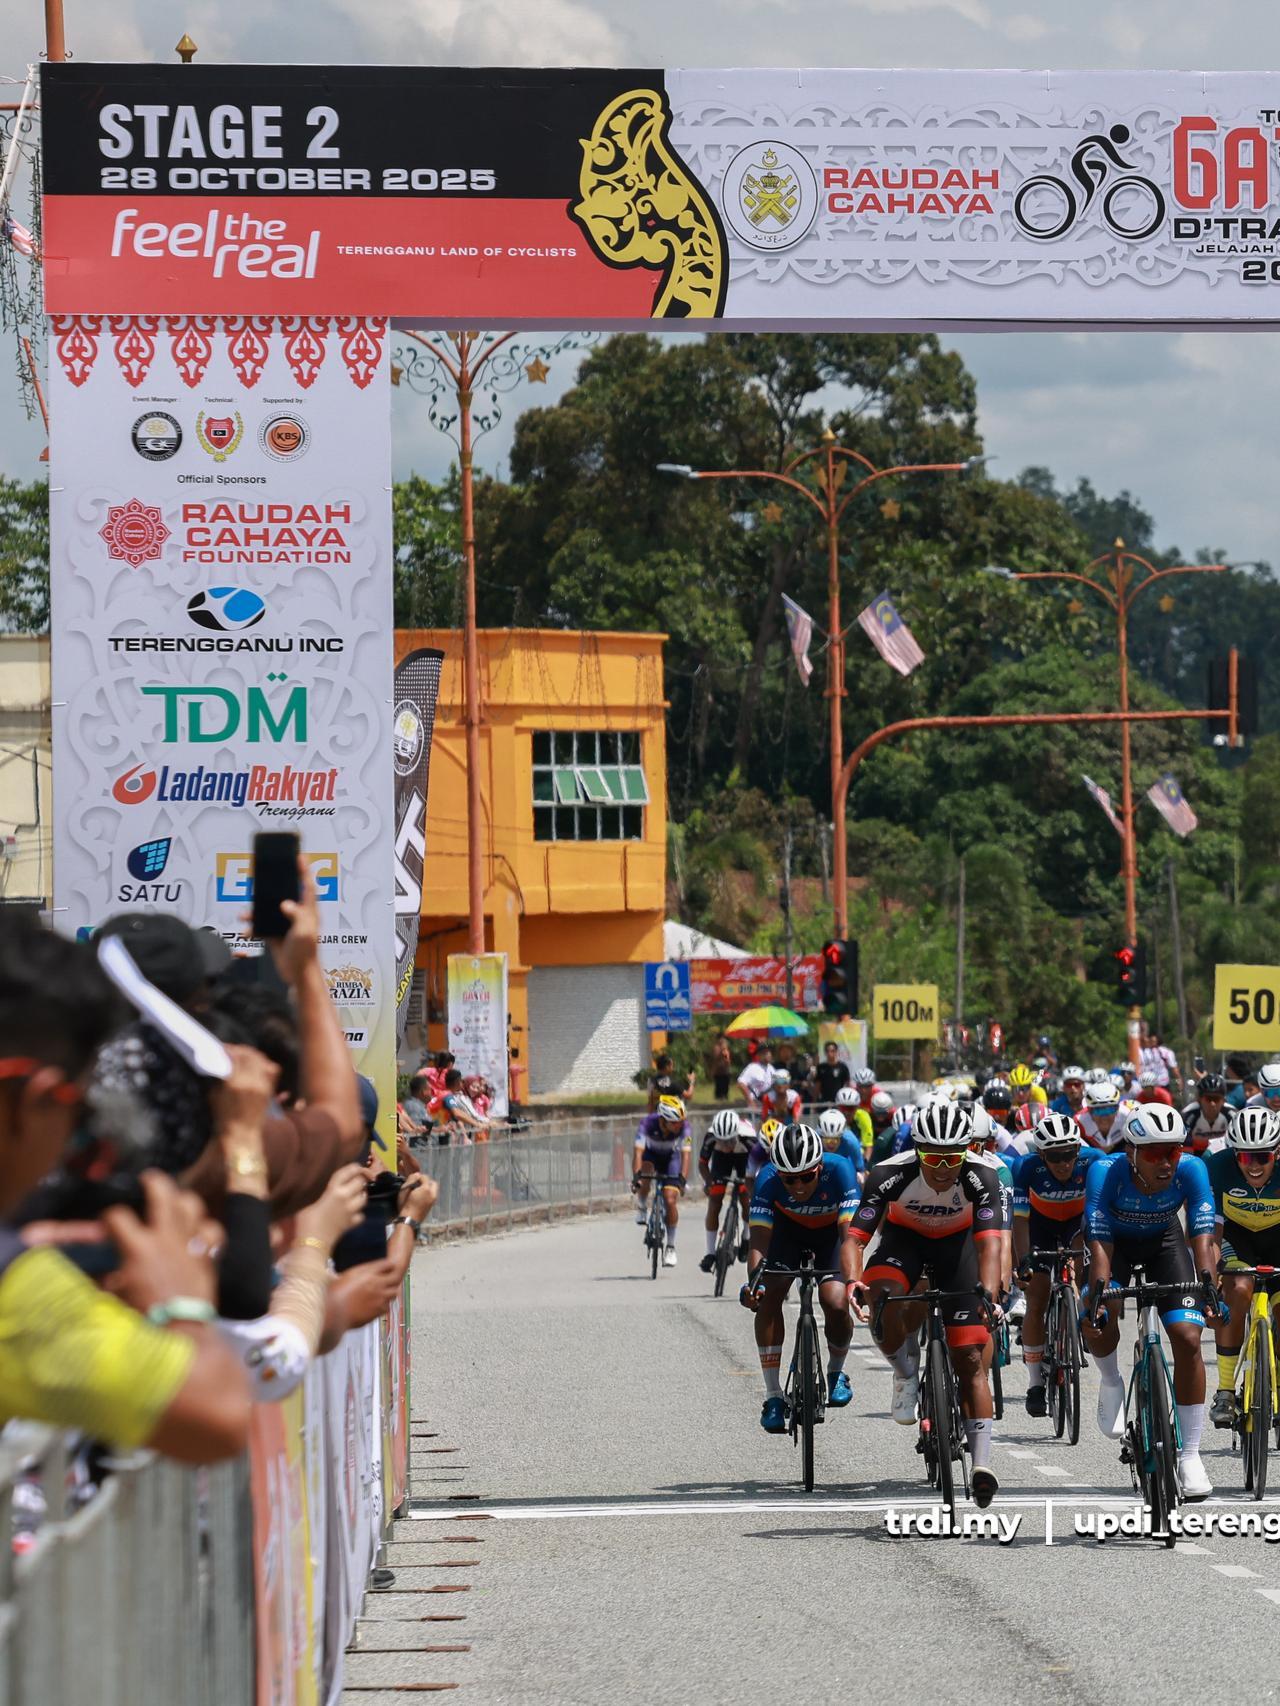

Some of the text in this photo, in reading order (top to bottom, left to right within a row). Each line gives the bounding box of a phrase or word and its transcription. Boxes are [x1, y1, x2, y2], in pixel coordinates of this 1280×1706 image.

[99, 104, 340, 159] STAGE 2
[100, 168, 497, 191] 28 OCTOBER 2025
[823, 168, 999, 190] RAUDAH
[827, 193, 995, 215] CAHAYA
[110, 209, 287, 260] feel the
[214, 231, 320, 279] real
[337, 246, 577, 257] TERENGGANU LAND OF CYCLISTS
[1195, 245, 1275, 254] JELAJAH
[277, 432, 299, 441] KBS
[177, 474, 266, 486] Official Sponsors
[182, 504, 352, 524] RAUDAH
[186, 527, 346, 547] CAHAYA
[183, 551, 352, 564] FOUNDATION
[108, 638, 344, 653] TERENGGANU INC
[140, 685, 307, 743] TDM
[255, 801, 336, 820] Trengganu
[118, 885, 181, 902] SATU
[317, 935, 368, 944] EJAR CREW
[879, 1000, 933, 1022] 100M
[966, 1170, 984, 1193] PDRM
